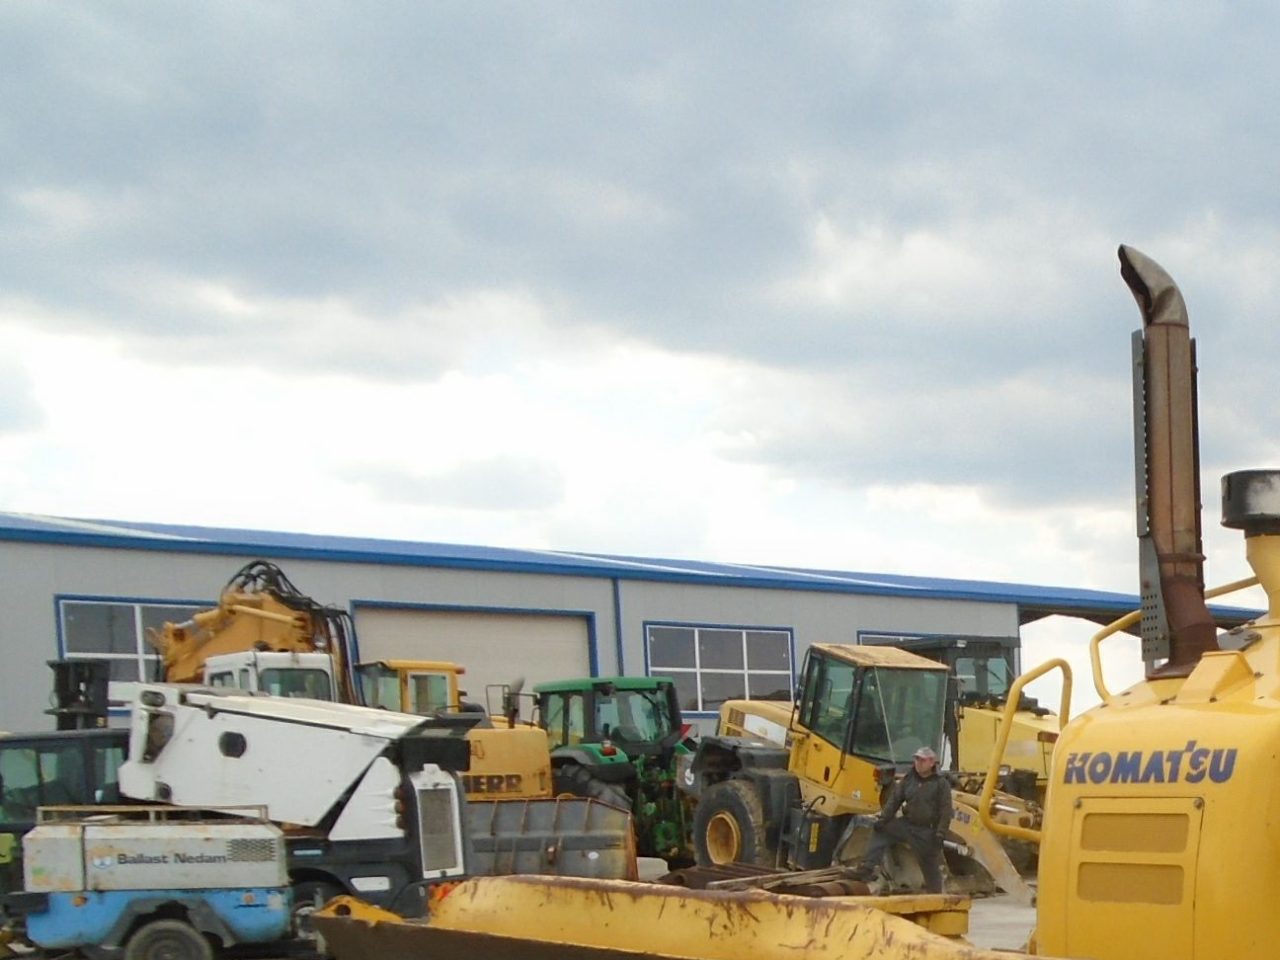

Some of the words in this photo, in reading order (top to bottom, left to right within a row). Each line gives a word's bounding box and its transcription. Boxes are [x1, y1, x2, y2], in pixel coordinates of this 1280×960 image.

[1062, 740, 1238, 785] KOMATSU
[117, 852, 168, 864] Ballast
[174, 852, 227, 864] Nedam
